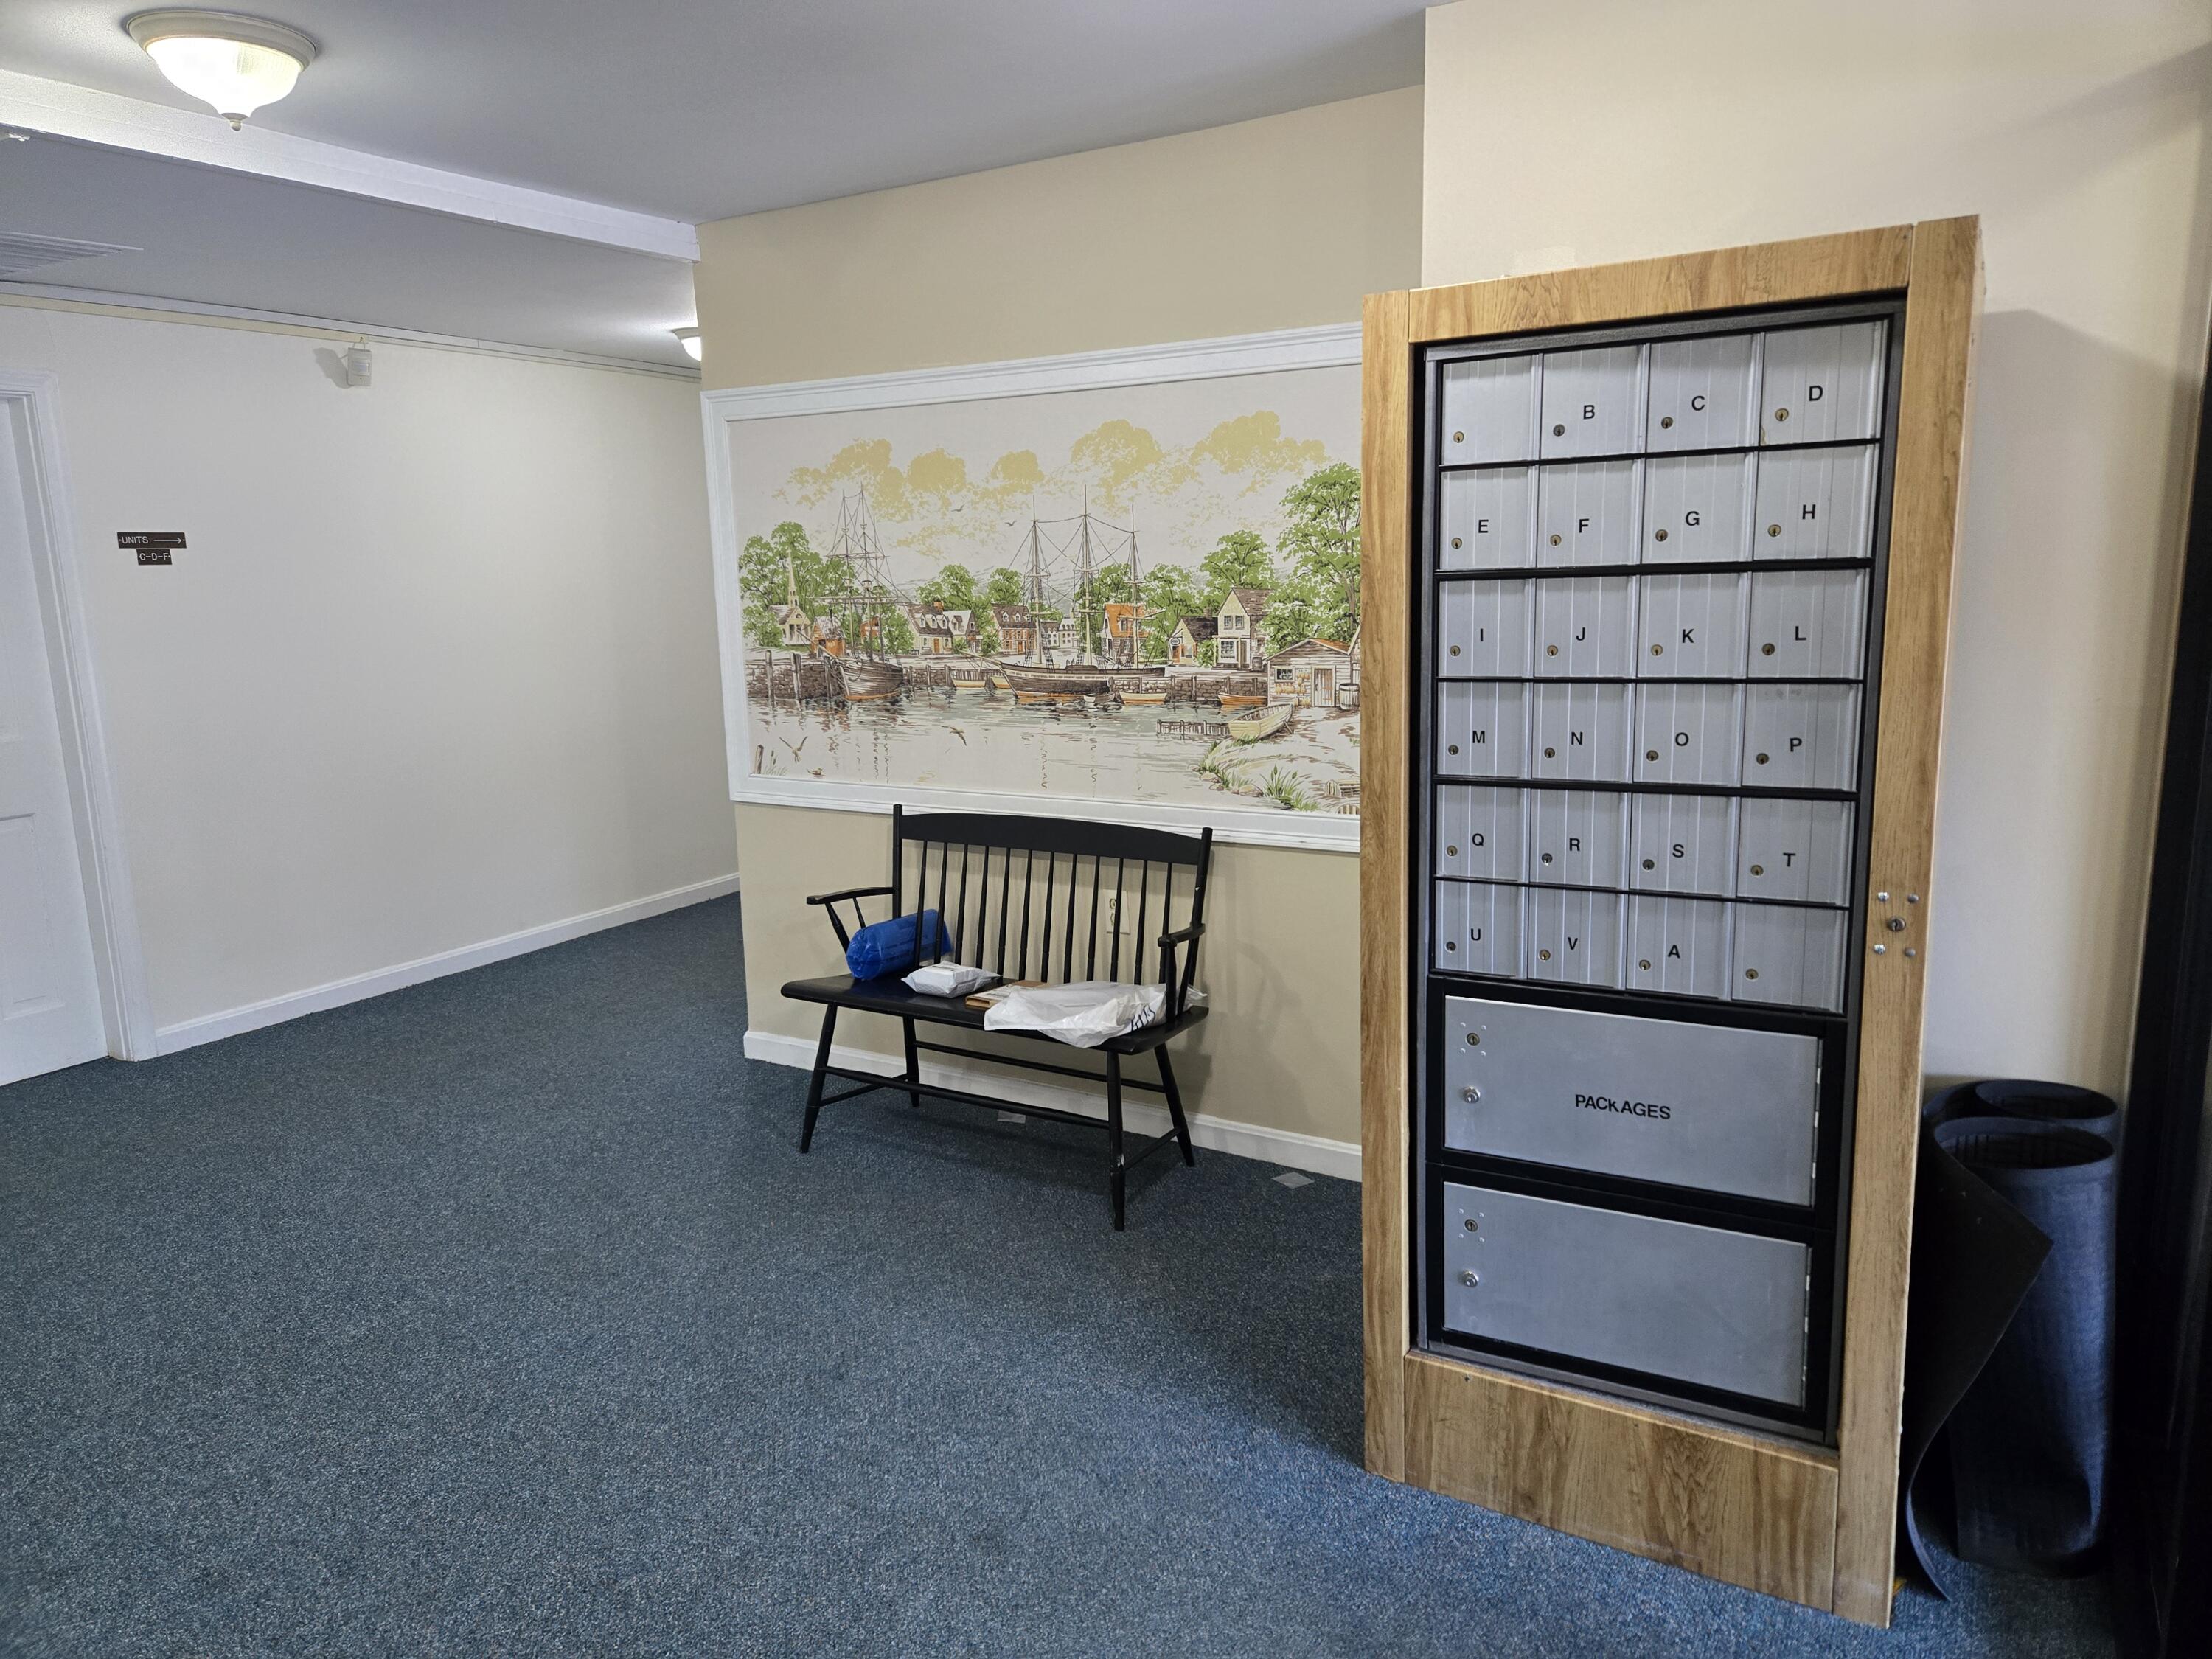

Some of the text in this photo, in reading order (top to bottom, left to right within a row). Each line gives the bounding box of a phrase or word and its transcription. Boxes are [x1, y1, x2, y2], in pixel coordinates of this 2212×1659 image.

[1809, 385, 1823, 402] D
[1691, 395, 1705, 411] C
[1583, 404, 1595, 420] B
[1685, 510, 1700, 526] G
[1802, 504, 1816, 520] H
[1478, 519, 1489, 534] E
[1579, 518, 1590, 533] F
[121, 536, 148, 544] UNITS
[1576, 627, 1586, 641] J
[1682, 628, 1694, 644] K
[1795, 625, 1807, 641] L
[1472, 730, 1486, 744] M
[1571, 731, 1583, 745] N
[1674, 731, 1689, 747] O
[1790, 737, 1803, 753] P
[1472, 832, 1484, 846] Q
[1569, 838, 1580, 852] R
[1672, 844, 1684, 858] S
[1783, 852, 1796, 867] T
[1470, 928, 1481, 941] U
[1568, 936, 1579, 950] V
[1667, 944, 1680, 959] A
[1575, 1093, 1671, 1120] PACKAGES
